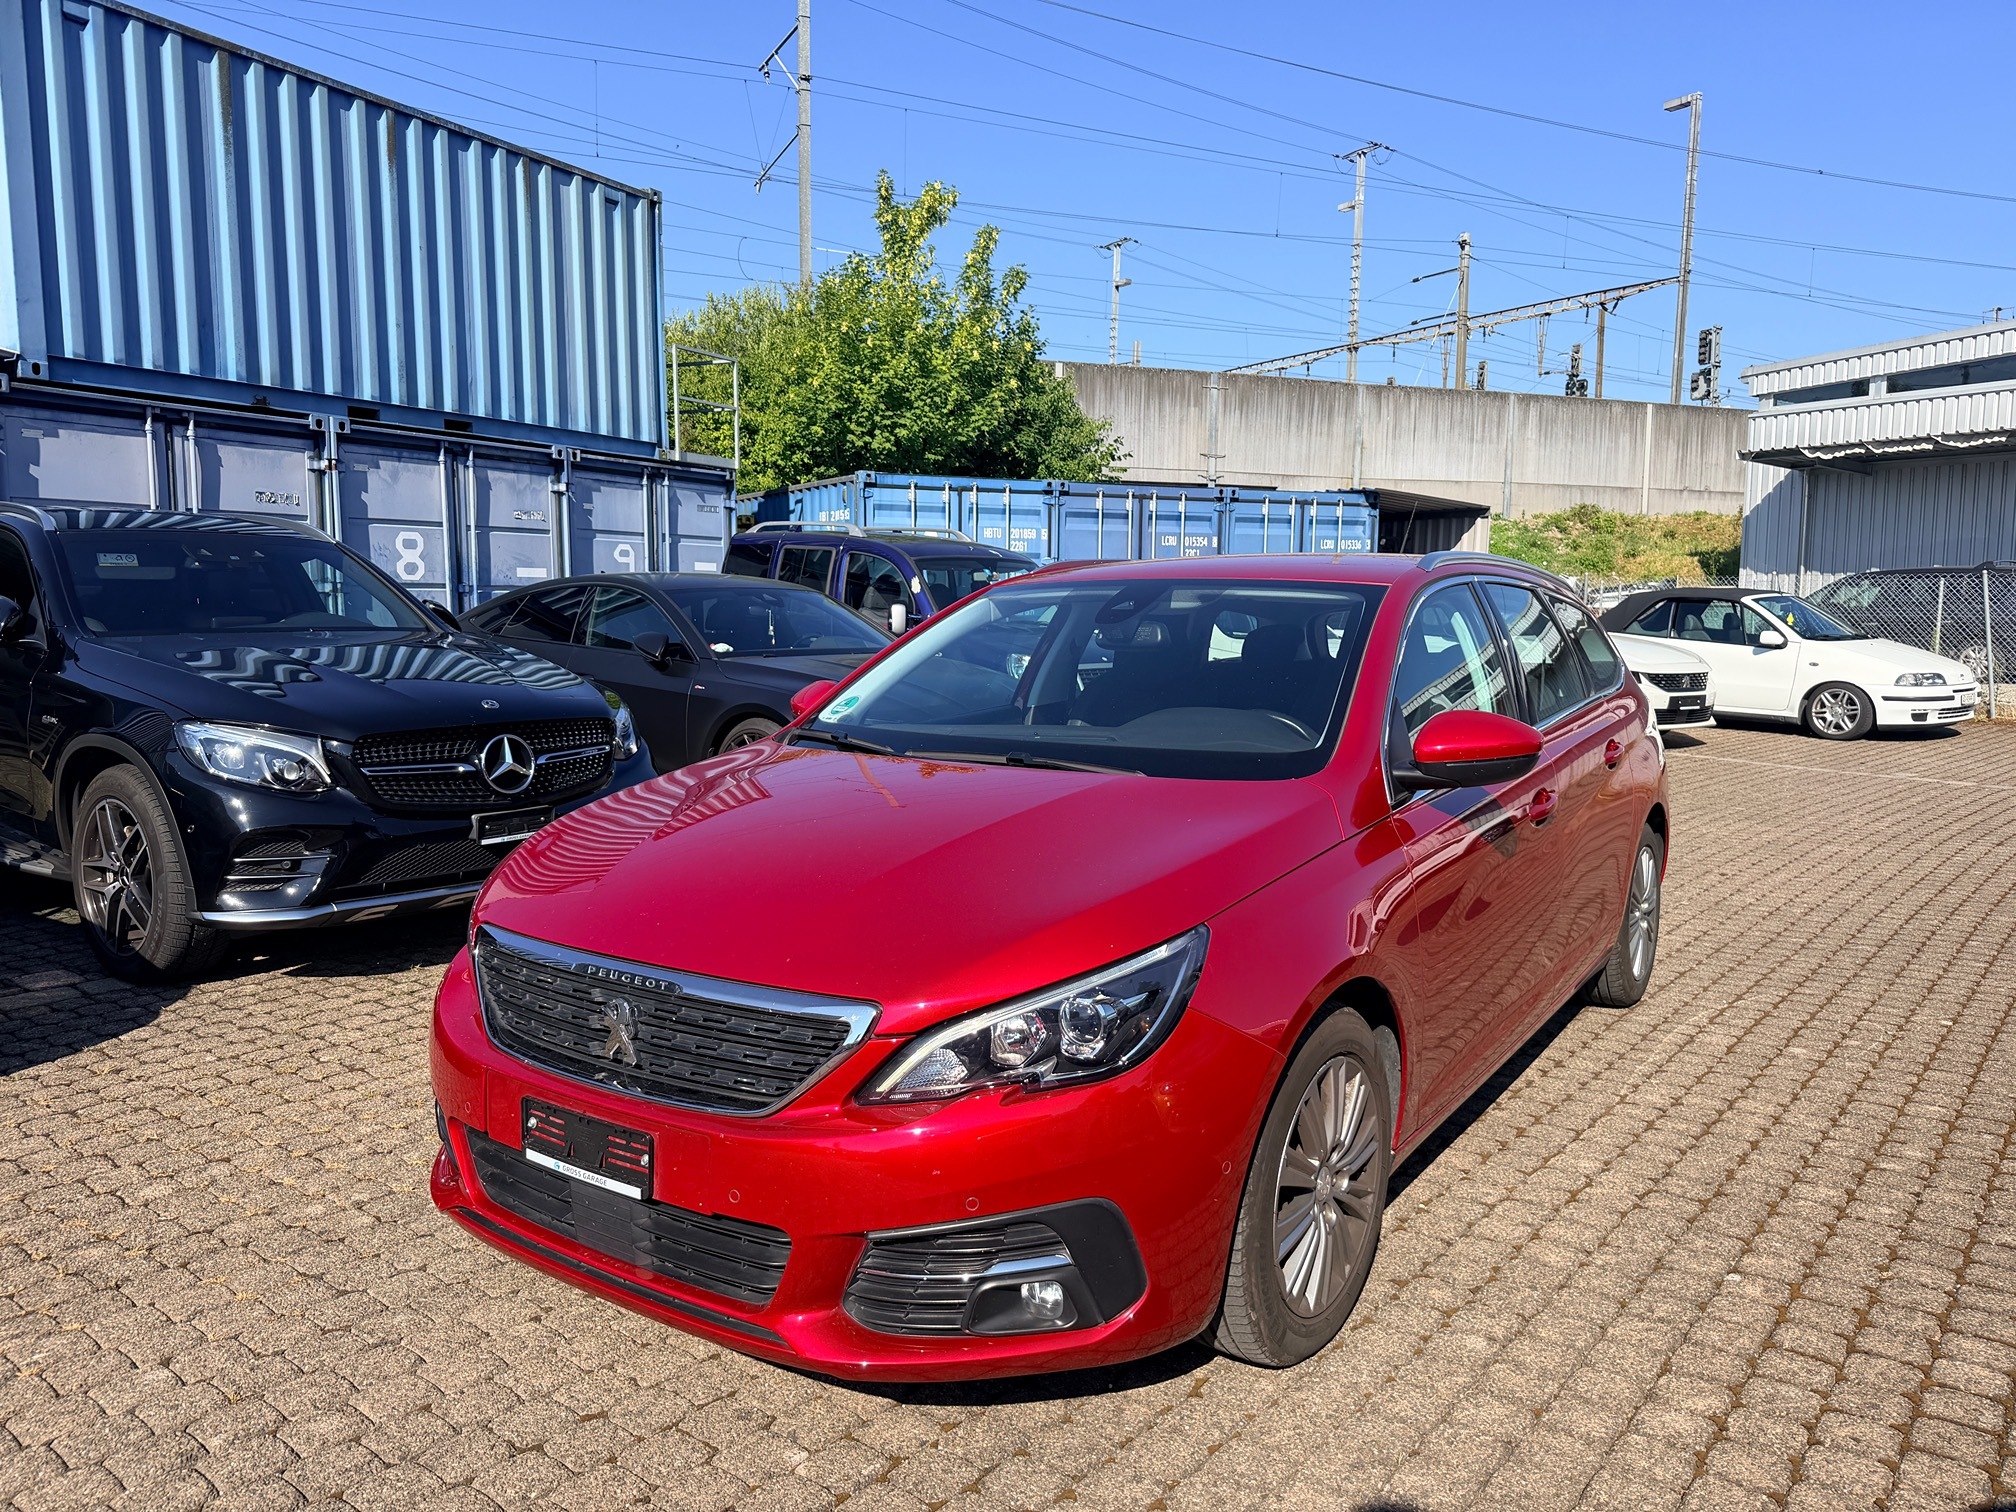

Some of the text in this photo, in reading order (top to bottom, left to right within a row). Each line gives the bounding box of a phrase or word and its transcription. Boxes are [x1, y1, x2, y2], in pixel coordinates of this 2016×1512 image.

[983, 527, 1002, 539] HBTU
[1010, 528, 1037, 540] 201859
[1161, 535, 1177, 546] LCRU
[1184, 536, 1208, 547] 015354
[395, 531, 425, 580] 8
[613, 543, 635, 572] 9
[587, 965, 669, 990] PEUGEOT
[562, 1165, 581, 1177] GROSS
[582, 1172, 607, 1187] GARAGE
